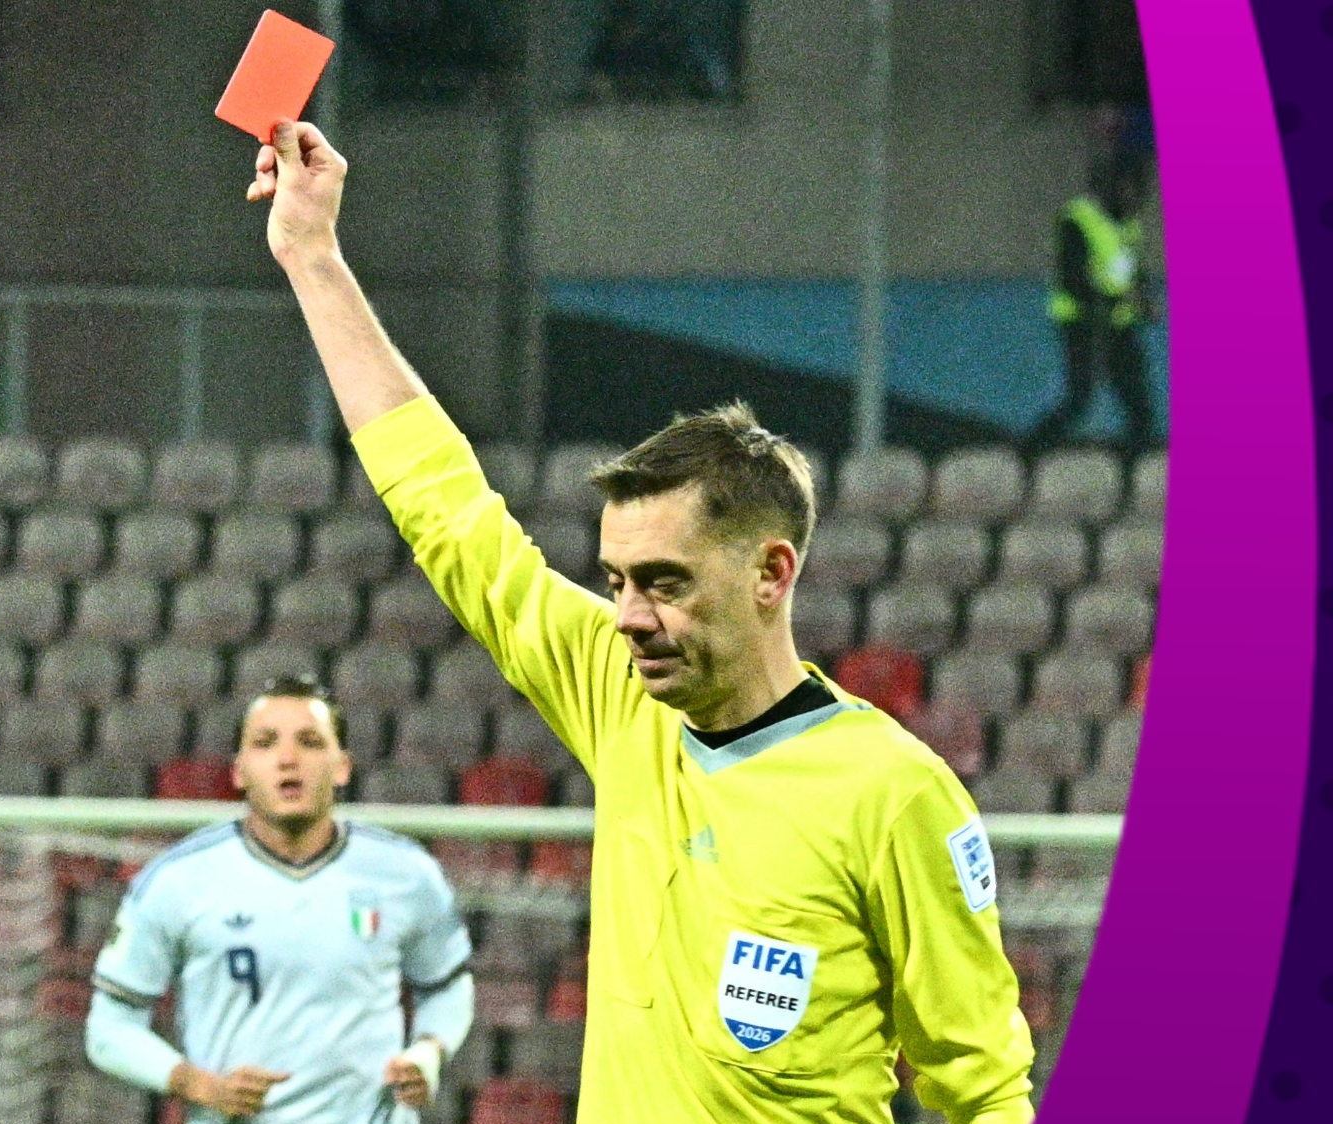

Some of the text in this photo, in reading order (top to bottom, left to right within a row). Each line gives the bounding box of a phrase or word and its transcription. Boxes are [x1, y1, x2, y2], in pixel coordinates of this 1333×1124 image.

[227, 946, 261, 1004] 9
[733, 940, 804, 979] FIFA
[724, 984, 799, 1011] REFEREE
[735, 1024, 772, 1042] 2026
